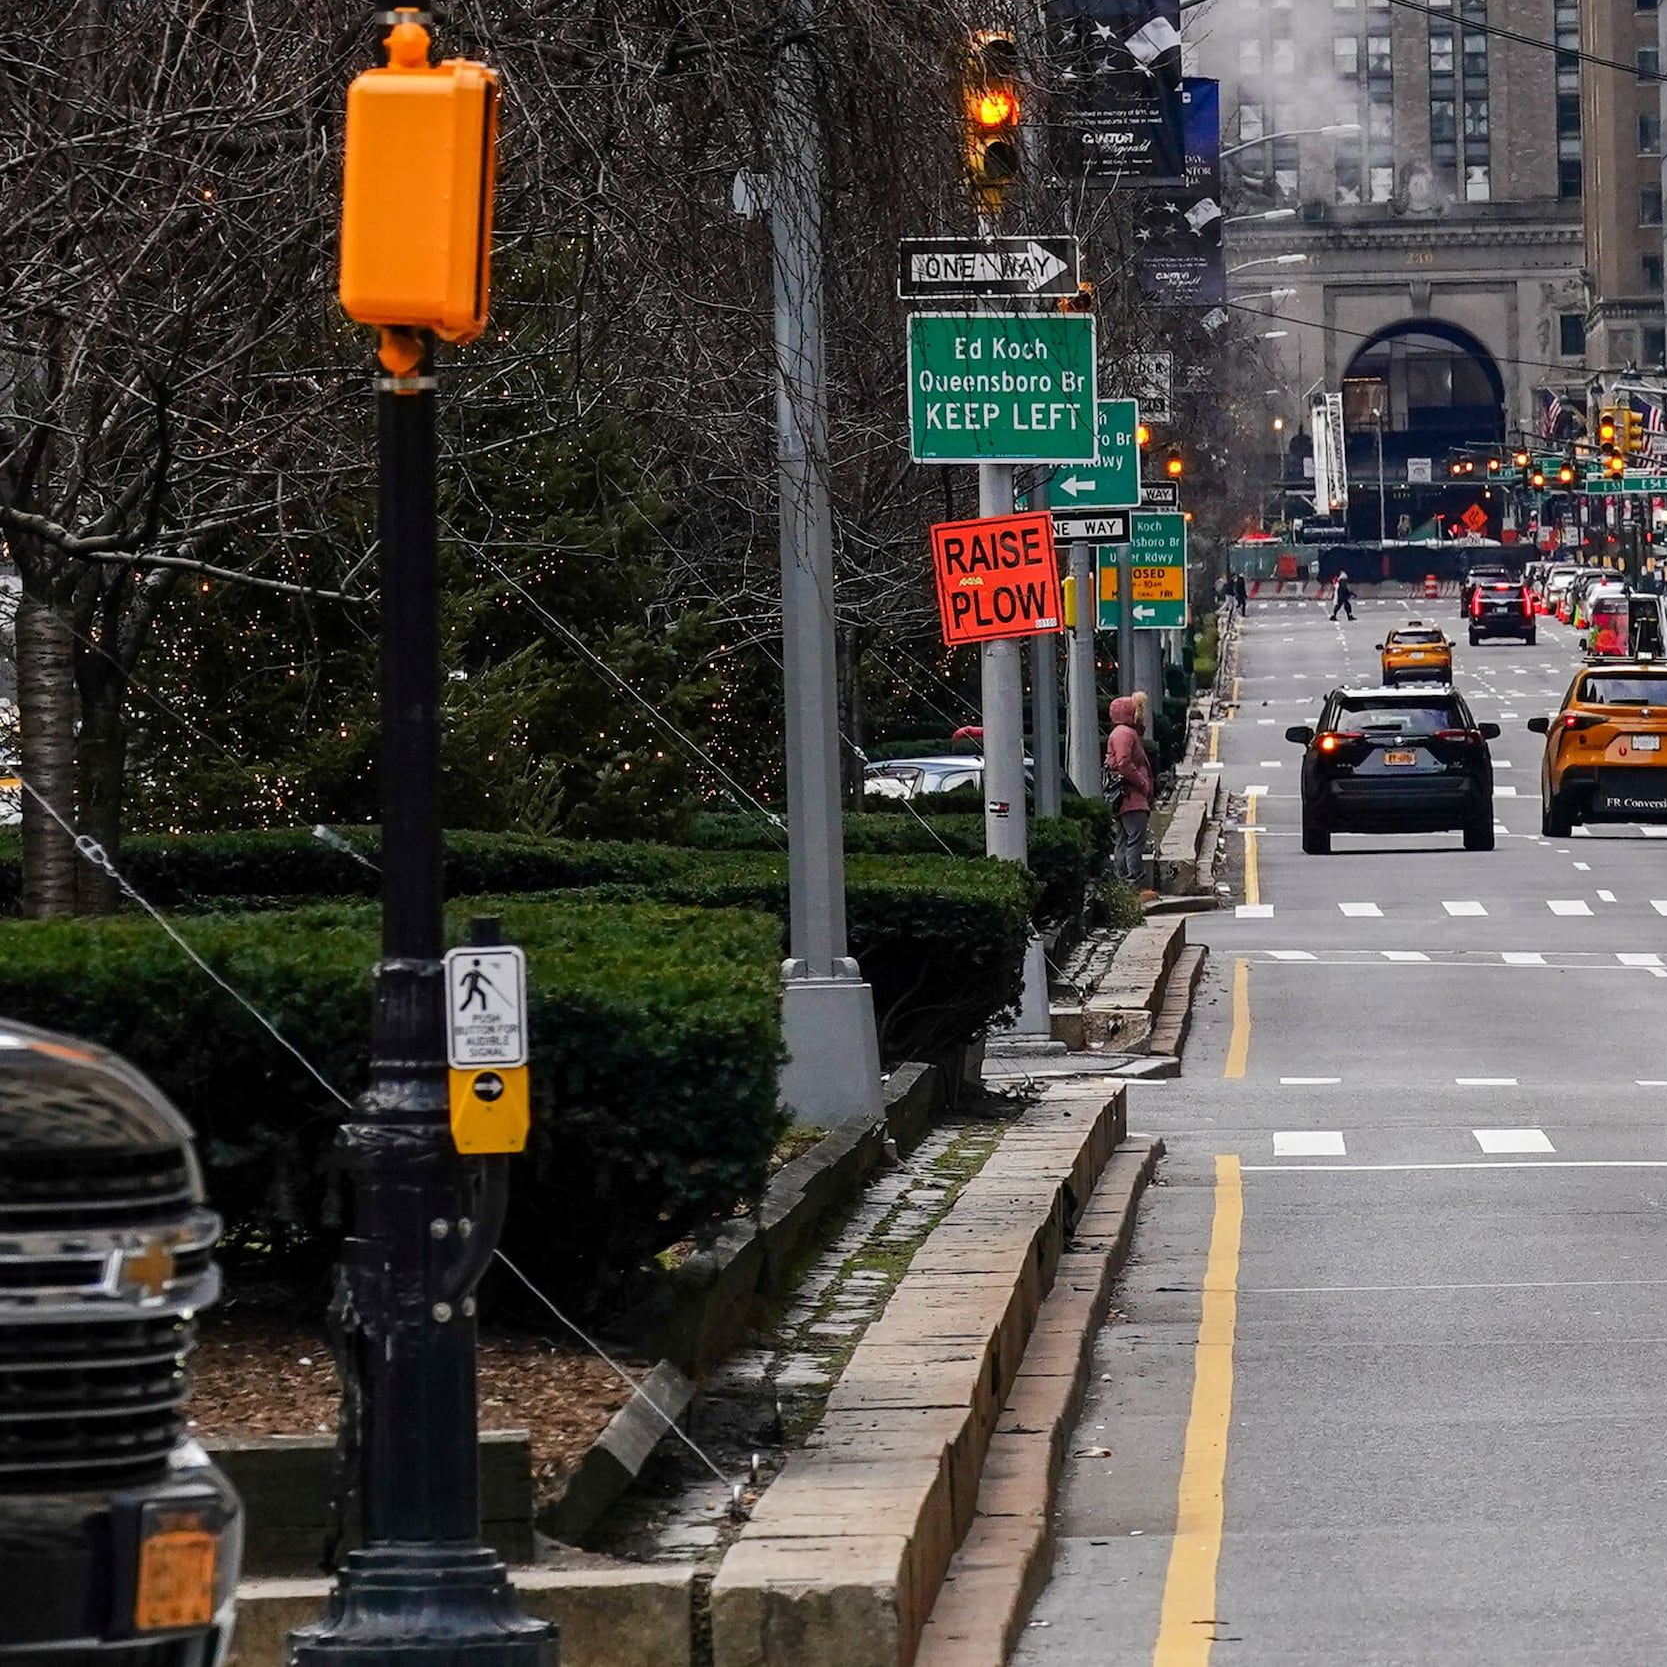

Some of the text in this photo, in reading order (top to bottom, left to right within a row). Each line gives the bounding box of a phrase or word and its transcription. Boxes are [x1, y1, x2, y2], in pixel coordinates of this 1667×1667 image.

[926, 255, 1050, 278] ONE WAY
[955, 337, 1047, 360] Ed Koch
[919, 370, 1085, 393] Queensboro Br
[926, 403, 1081, 430] KEEP LEFT
[1116, 432, 1131, 446] Br
[1642, 480, 1648, 489] E
[1146, 489, 1170, 501] WAY
[1084, 520, 1117, 535] WAY
[1137, 520, 1162, 532] Koch
[1169, 535, 1179, 547] Br
[943, 527, 1043, 576] RAISE
[1144, 552, 1173, 565] Rdwy
[951, 580, 1047, 630] PLOW
[1606, 797, 1621, 807] FR
[472, 1014, 501, 1023] PUSH
[455, 1024, 519, 1035] BUTTON FOR
[465, 1036, 509, 1046] AUDIBLE
[469, 1048, 506, 1058] SIGNAL
